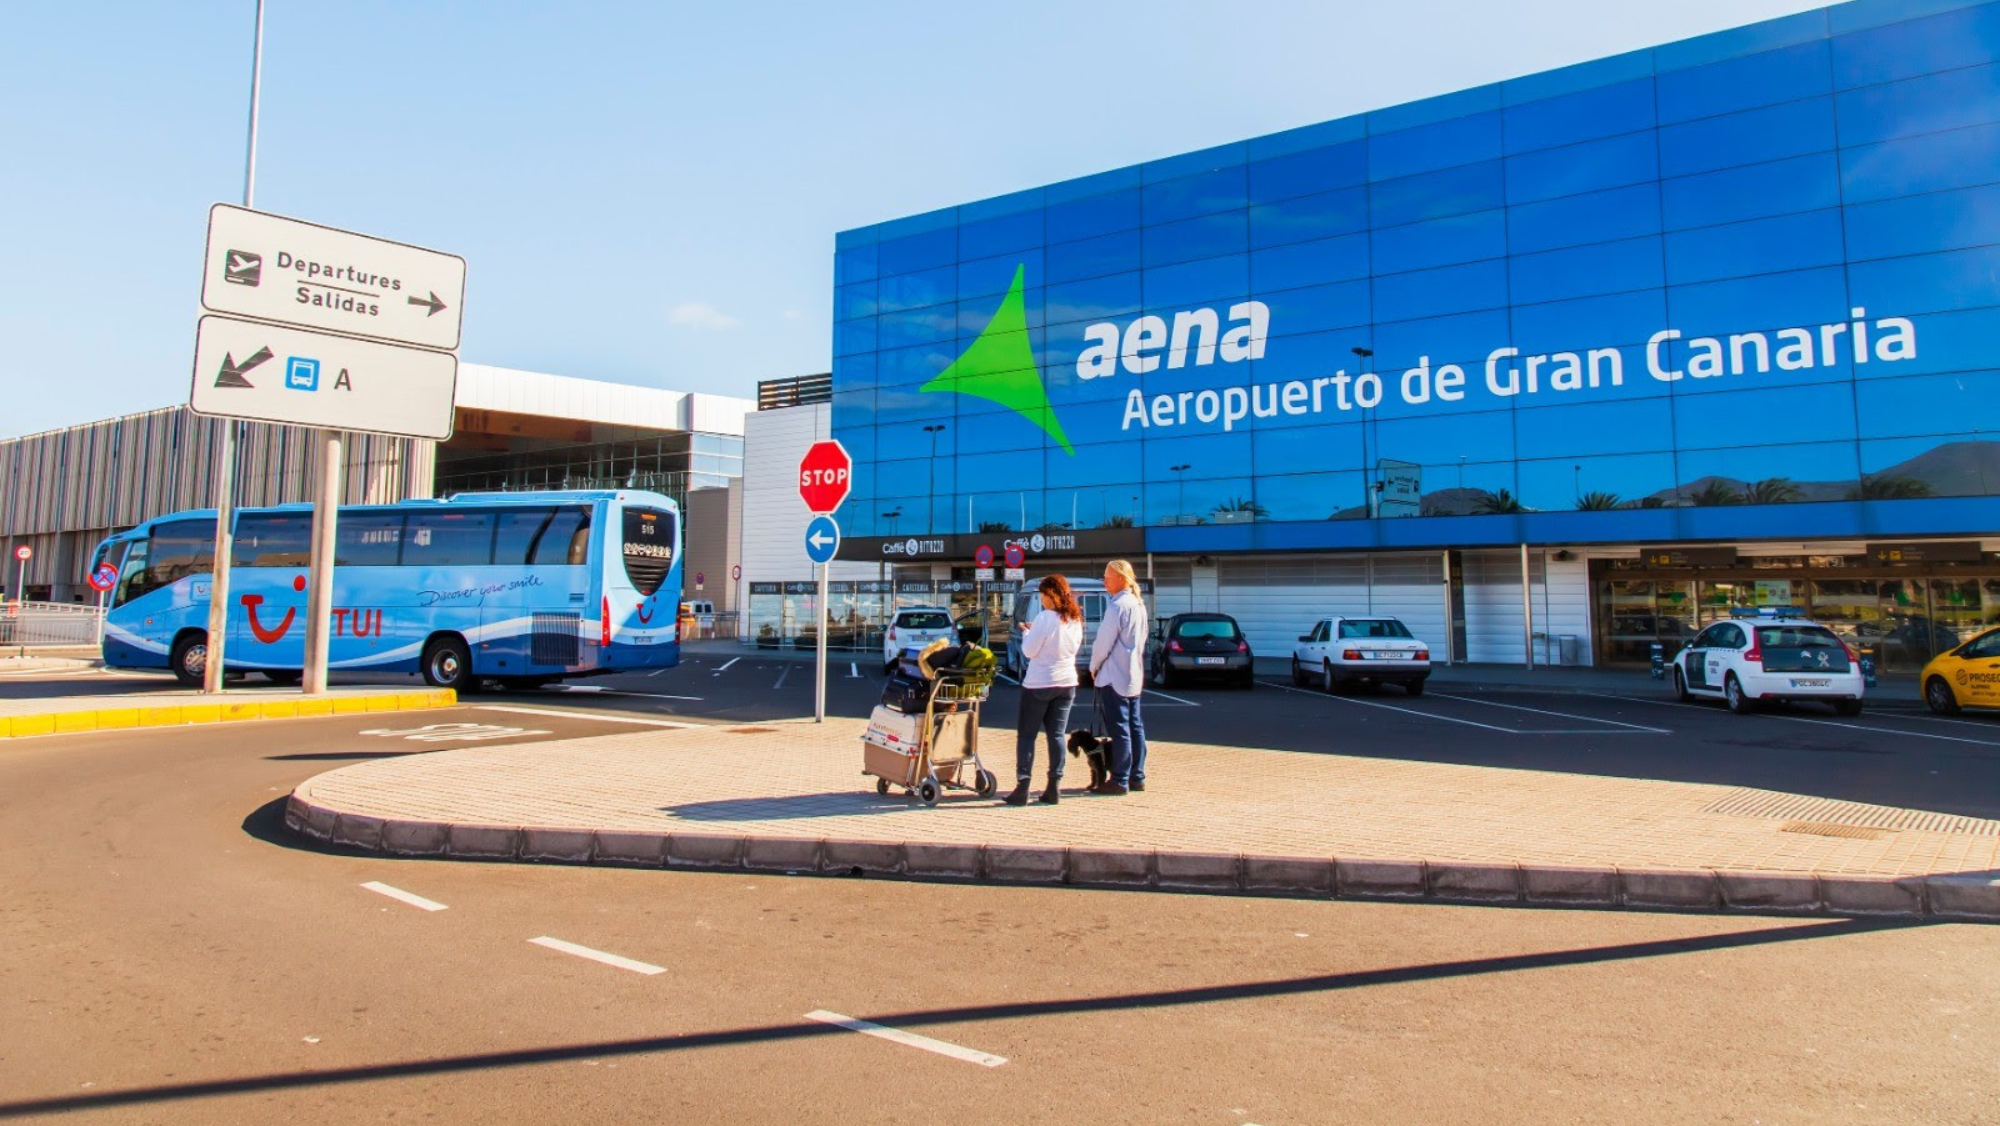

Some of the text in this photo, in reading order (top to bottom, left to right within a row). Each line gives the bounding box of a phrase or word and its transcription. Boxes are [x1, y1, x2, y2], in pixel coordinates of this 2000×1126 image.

[277, 251, 401, 291] Departures
[296, 287, 380, 316] Salidas
[1076, 300, 1270, 381] aena
[333, 368, 352, 391] A
[1121, 306, 1917, 432] Aeropuerto de Gran Canaria
[801, 468, 847, 487] STOP
[882, 541, 905, 554] Caffè
[416, 575, 544, 607] Discover your smile
[332, 608, 382, 637] TUI
